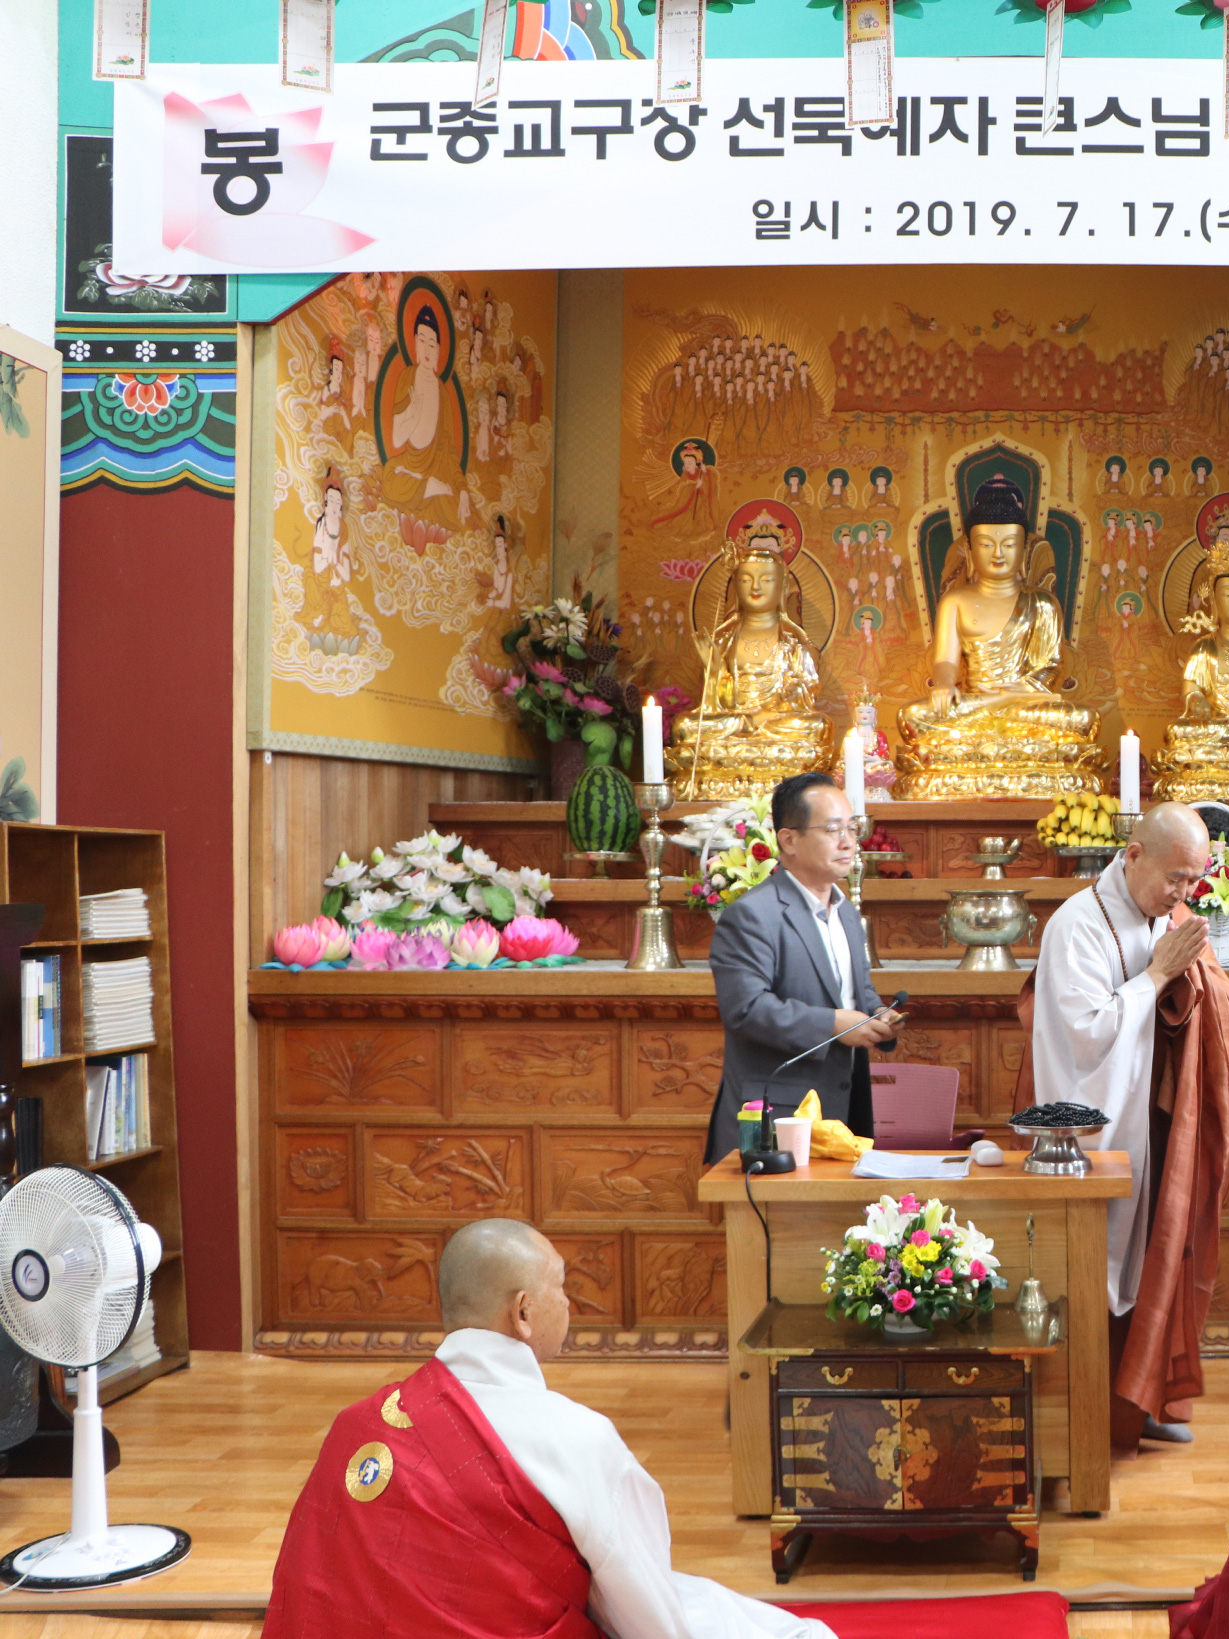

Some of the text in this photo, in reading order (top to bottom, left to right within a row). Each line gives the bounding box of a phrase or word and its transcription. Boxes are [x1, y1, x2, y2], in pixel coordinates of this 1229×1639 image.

[371, 100, 707, 164] 군종교구장
[1013, 97, 1210, 157] 큰스님
[201, 129, 283, 216] 봉
[752, 199, 839, 240] 일시
[896, 200, 1031, 237] 2019.
[1057, 201, 1095, 237] 7.
